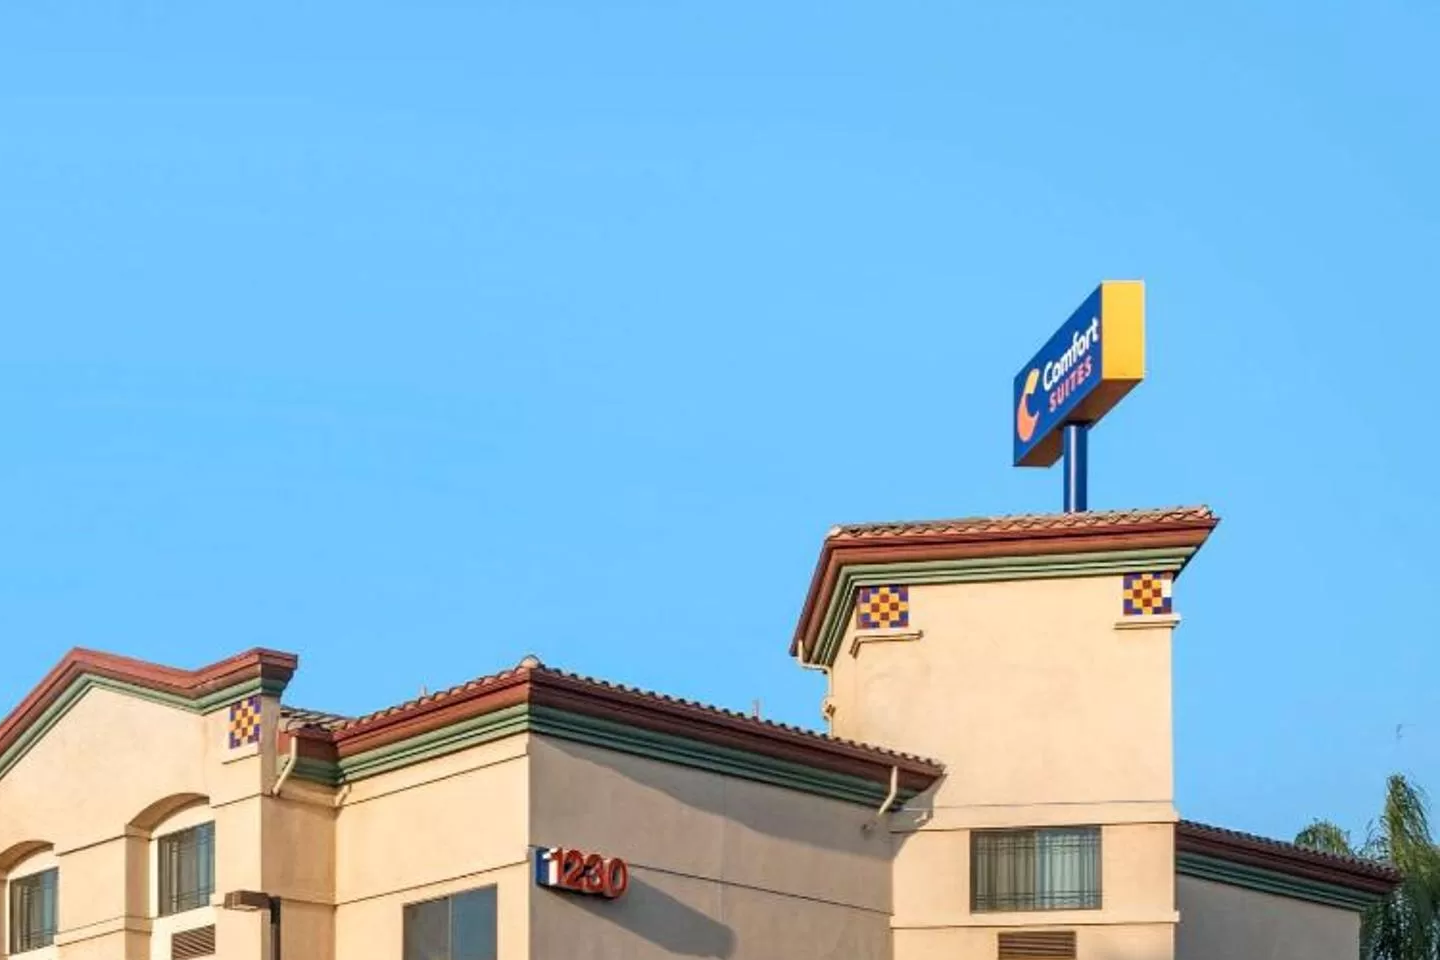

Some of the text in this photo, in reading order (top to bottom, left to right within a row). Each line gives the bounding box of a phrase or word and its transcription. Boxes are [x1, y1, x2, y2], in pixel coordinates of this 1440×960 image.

[1043, 317, 1099, 391] Comfort
[1049, 355, 1091, 413] SUITES
[543, 846, 628, 898] 1230
